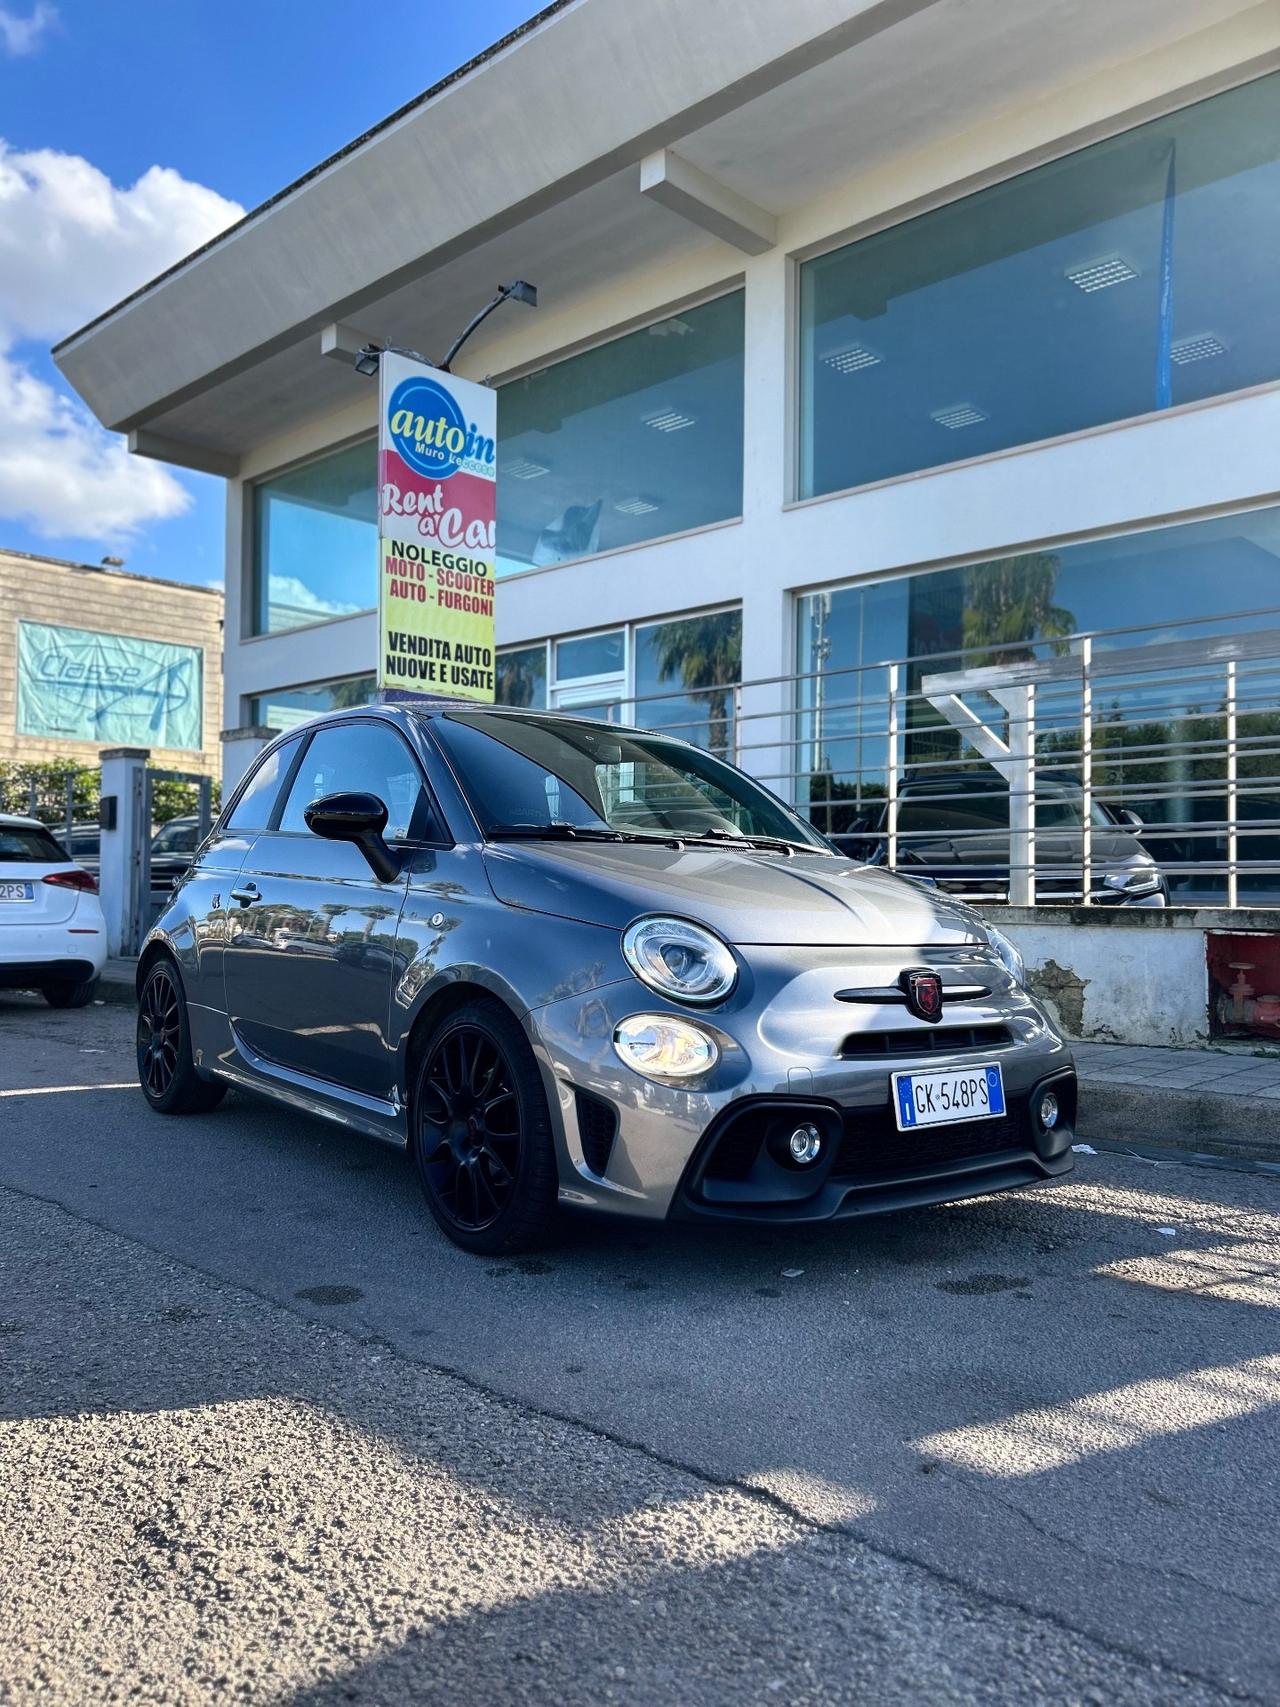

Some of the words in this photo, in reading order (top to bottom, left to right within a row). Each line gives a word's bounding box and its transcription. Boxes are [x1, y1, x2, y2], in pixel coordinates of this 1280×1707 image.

[415, 442, 445, 460] Muro
[383, 483, 444, 514] Rent
[385, 556, 426, 581] MOTO
[436, 567, 495, 597] SCOOTER
[392, 540, 488, 577] NOLEGGIO
[390, 578, 427, 602] AUTO
[437, 588, 493, 617] FURGONI
[387, 631, 452, 661] VENDITA
[454, 643, 492, 668] AUTO
[41, 656, 141, 684] Classe
[386, 654, 436, 682] NUOVE
[439, 663, 448, 683] E
[450, 665, 494, 691] USATE
